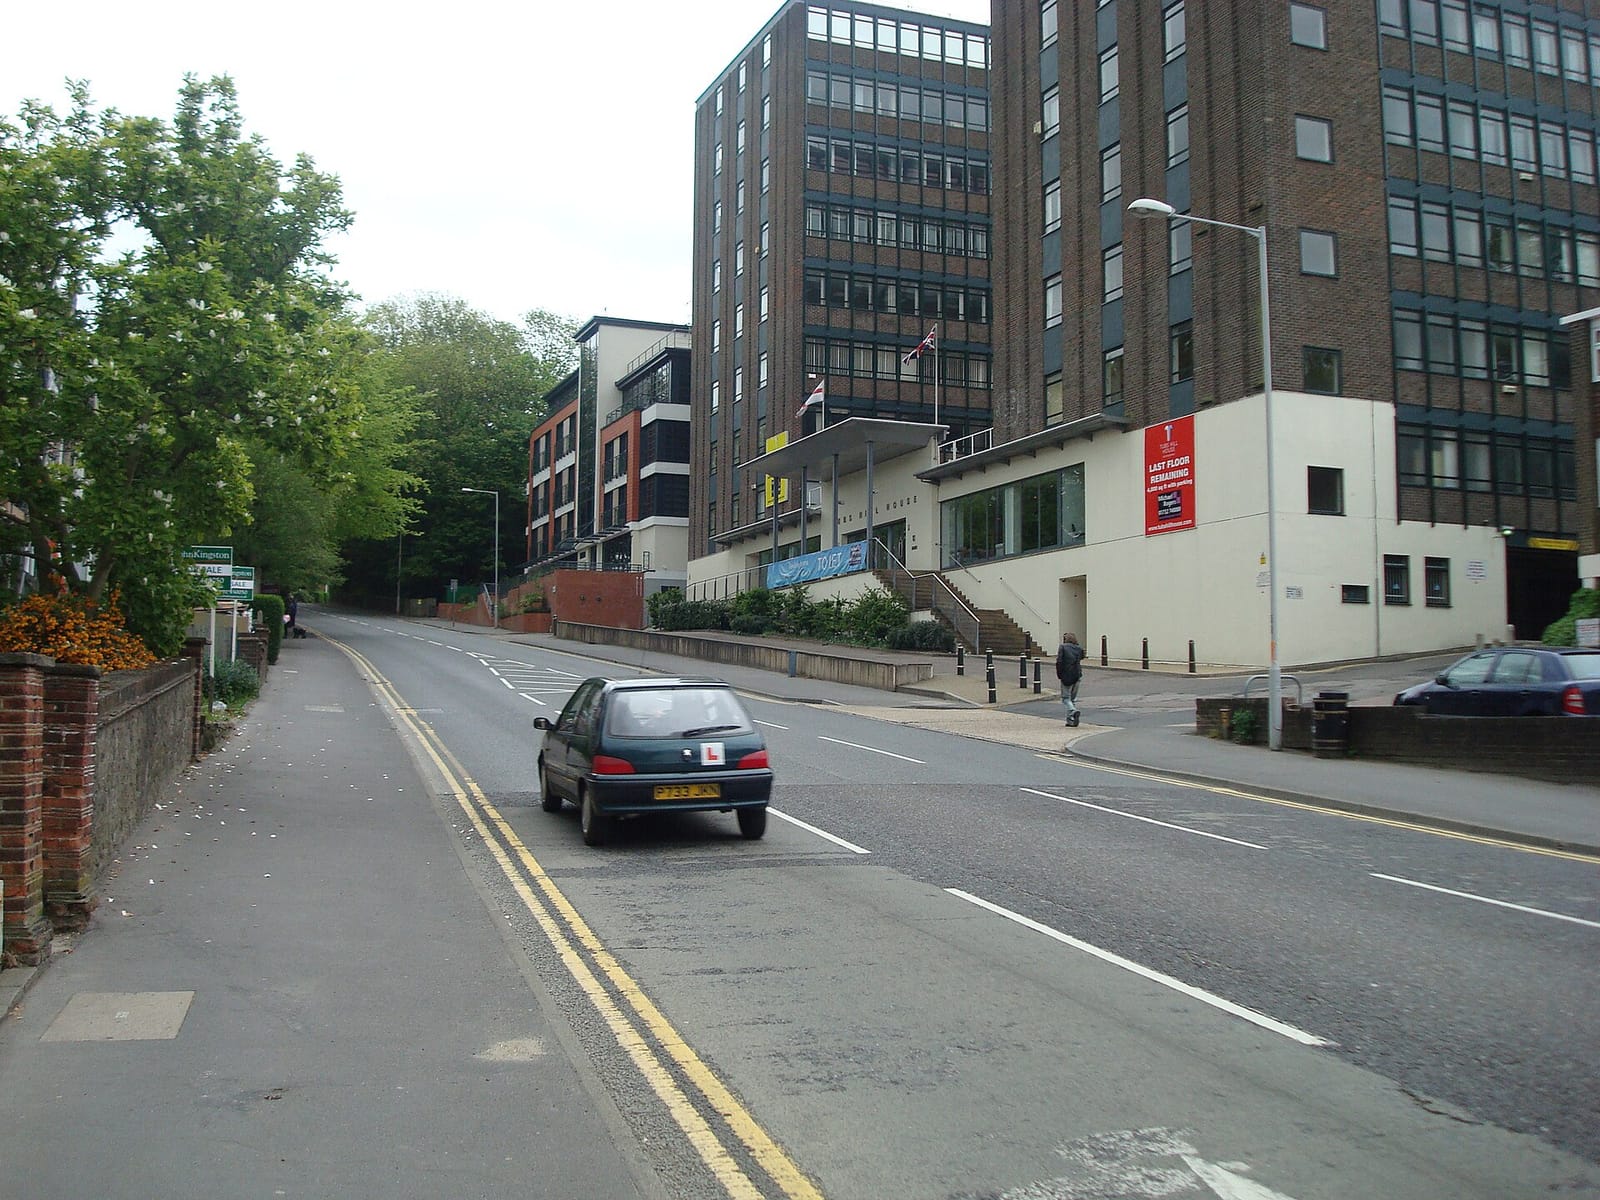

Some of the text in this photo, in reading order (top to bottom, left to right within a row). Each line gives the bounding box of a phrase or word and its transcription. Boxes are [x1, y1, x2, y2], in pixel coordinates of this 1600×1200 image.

[1149, 455, 1190, 473] LAST FLOOR
[1150, 468, 1189, 483] REMAINING
[837, 495, 918, 524] UBS HIL HOUSE
[817, 556, 829, 571] TO
[829, 552, 843, 569] LET
[706, 746, 719, 760] L
